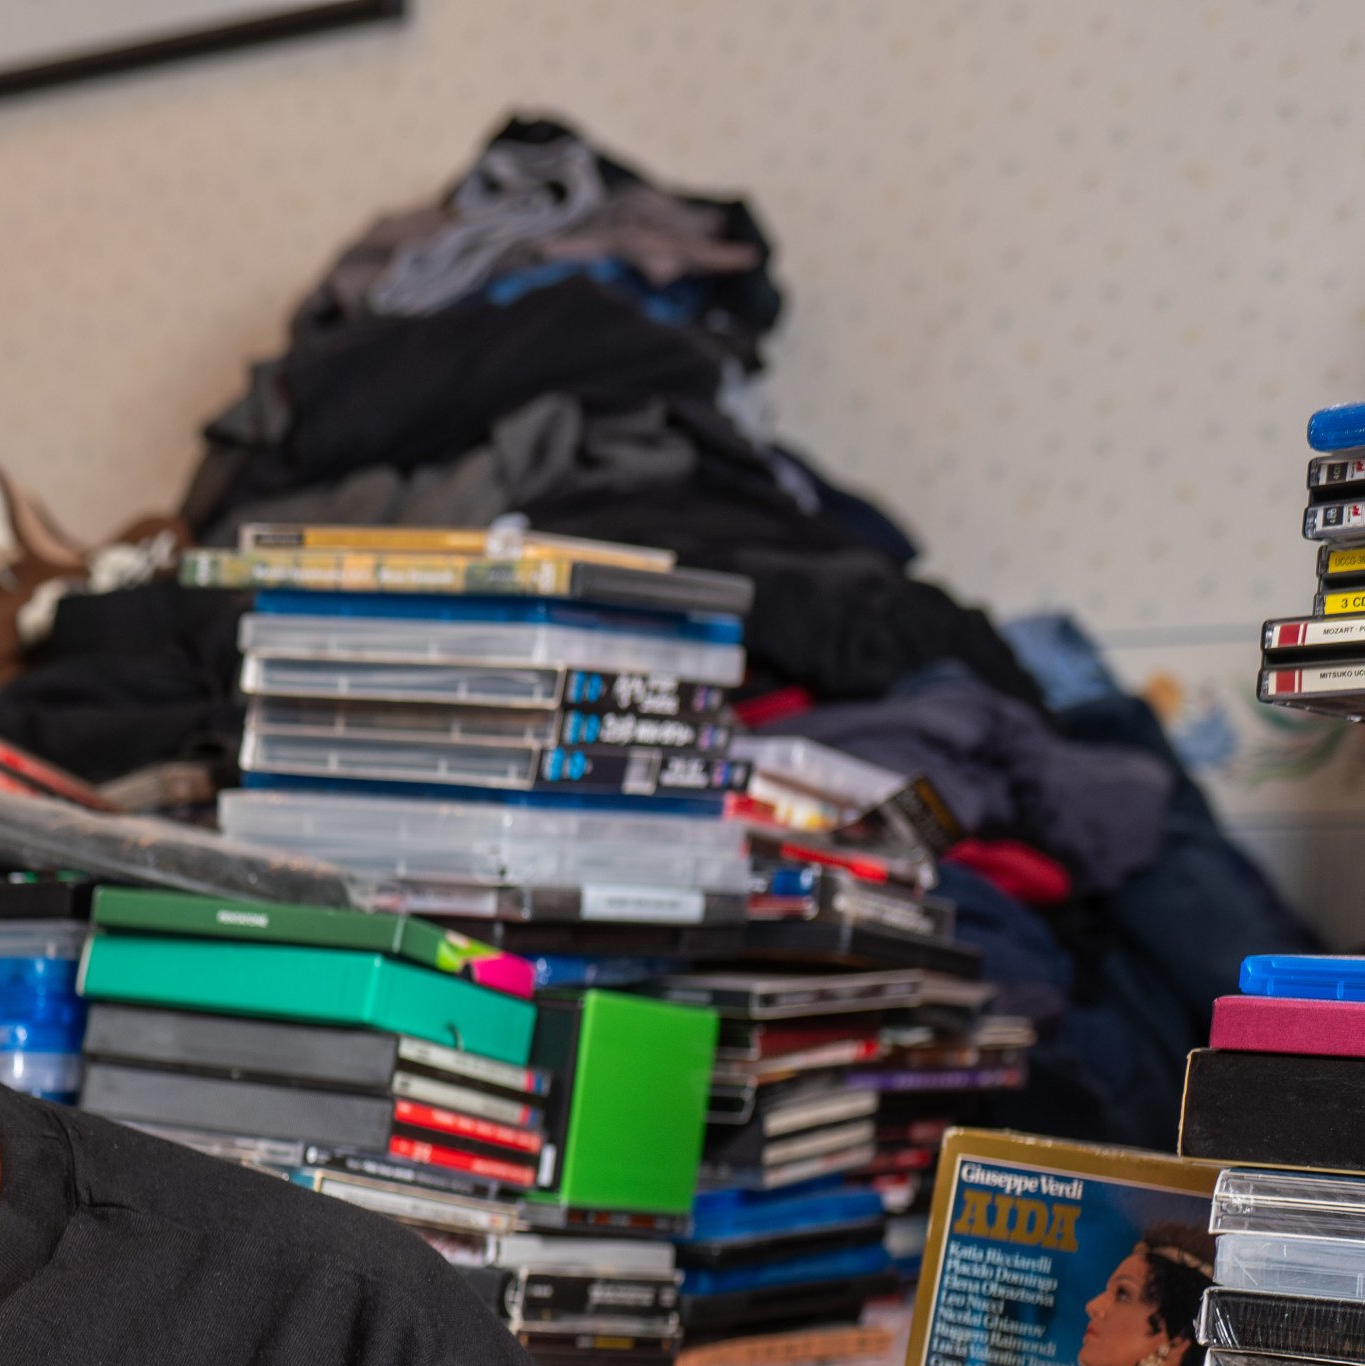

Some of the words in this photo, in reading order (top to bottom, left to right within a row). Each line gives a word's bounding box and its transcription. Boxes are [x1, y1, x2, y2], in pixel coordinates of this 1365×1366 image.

[1341, 599, 1348, 609] 3
[1323, 627, 1353, 636] MOZART
[1320, 671, 1352, 680] MITSUKO
[961, 1163, 1039, 1196] Giuseppe
[1040, 1175, 1084, 1200] Verdi
[954, 1189, 1081, 1253] AIDA
